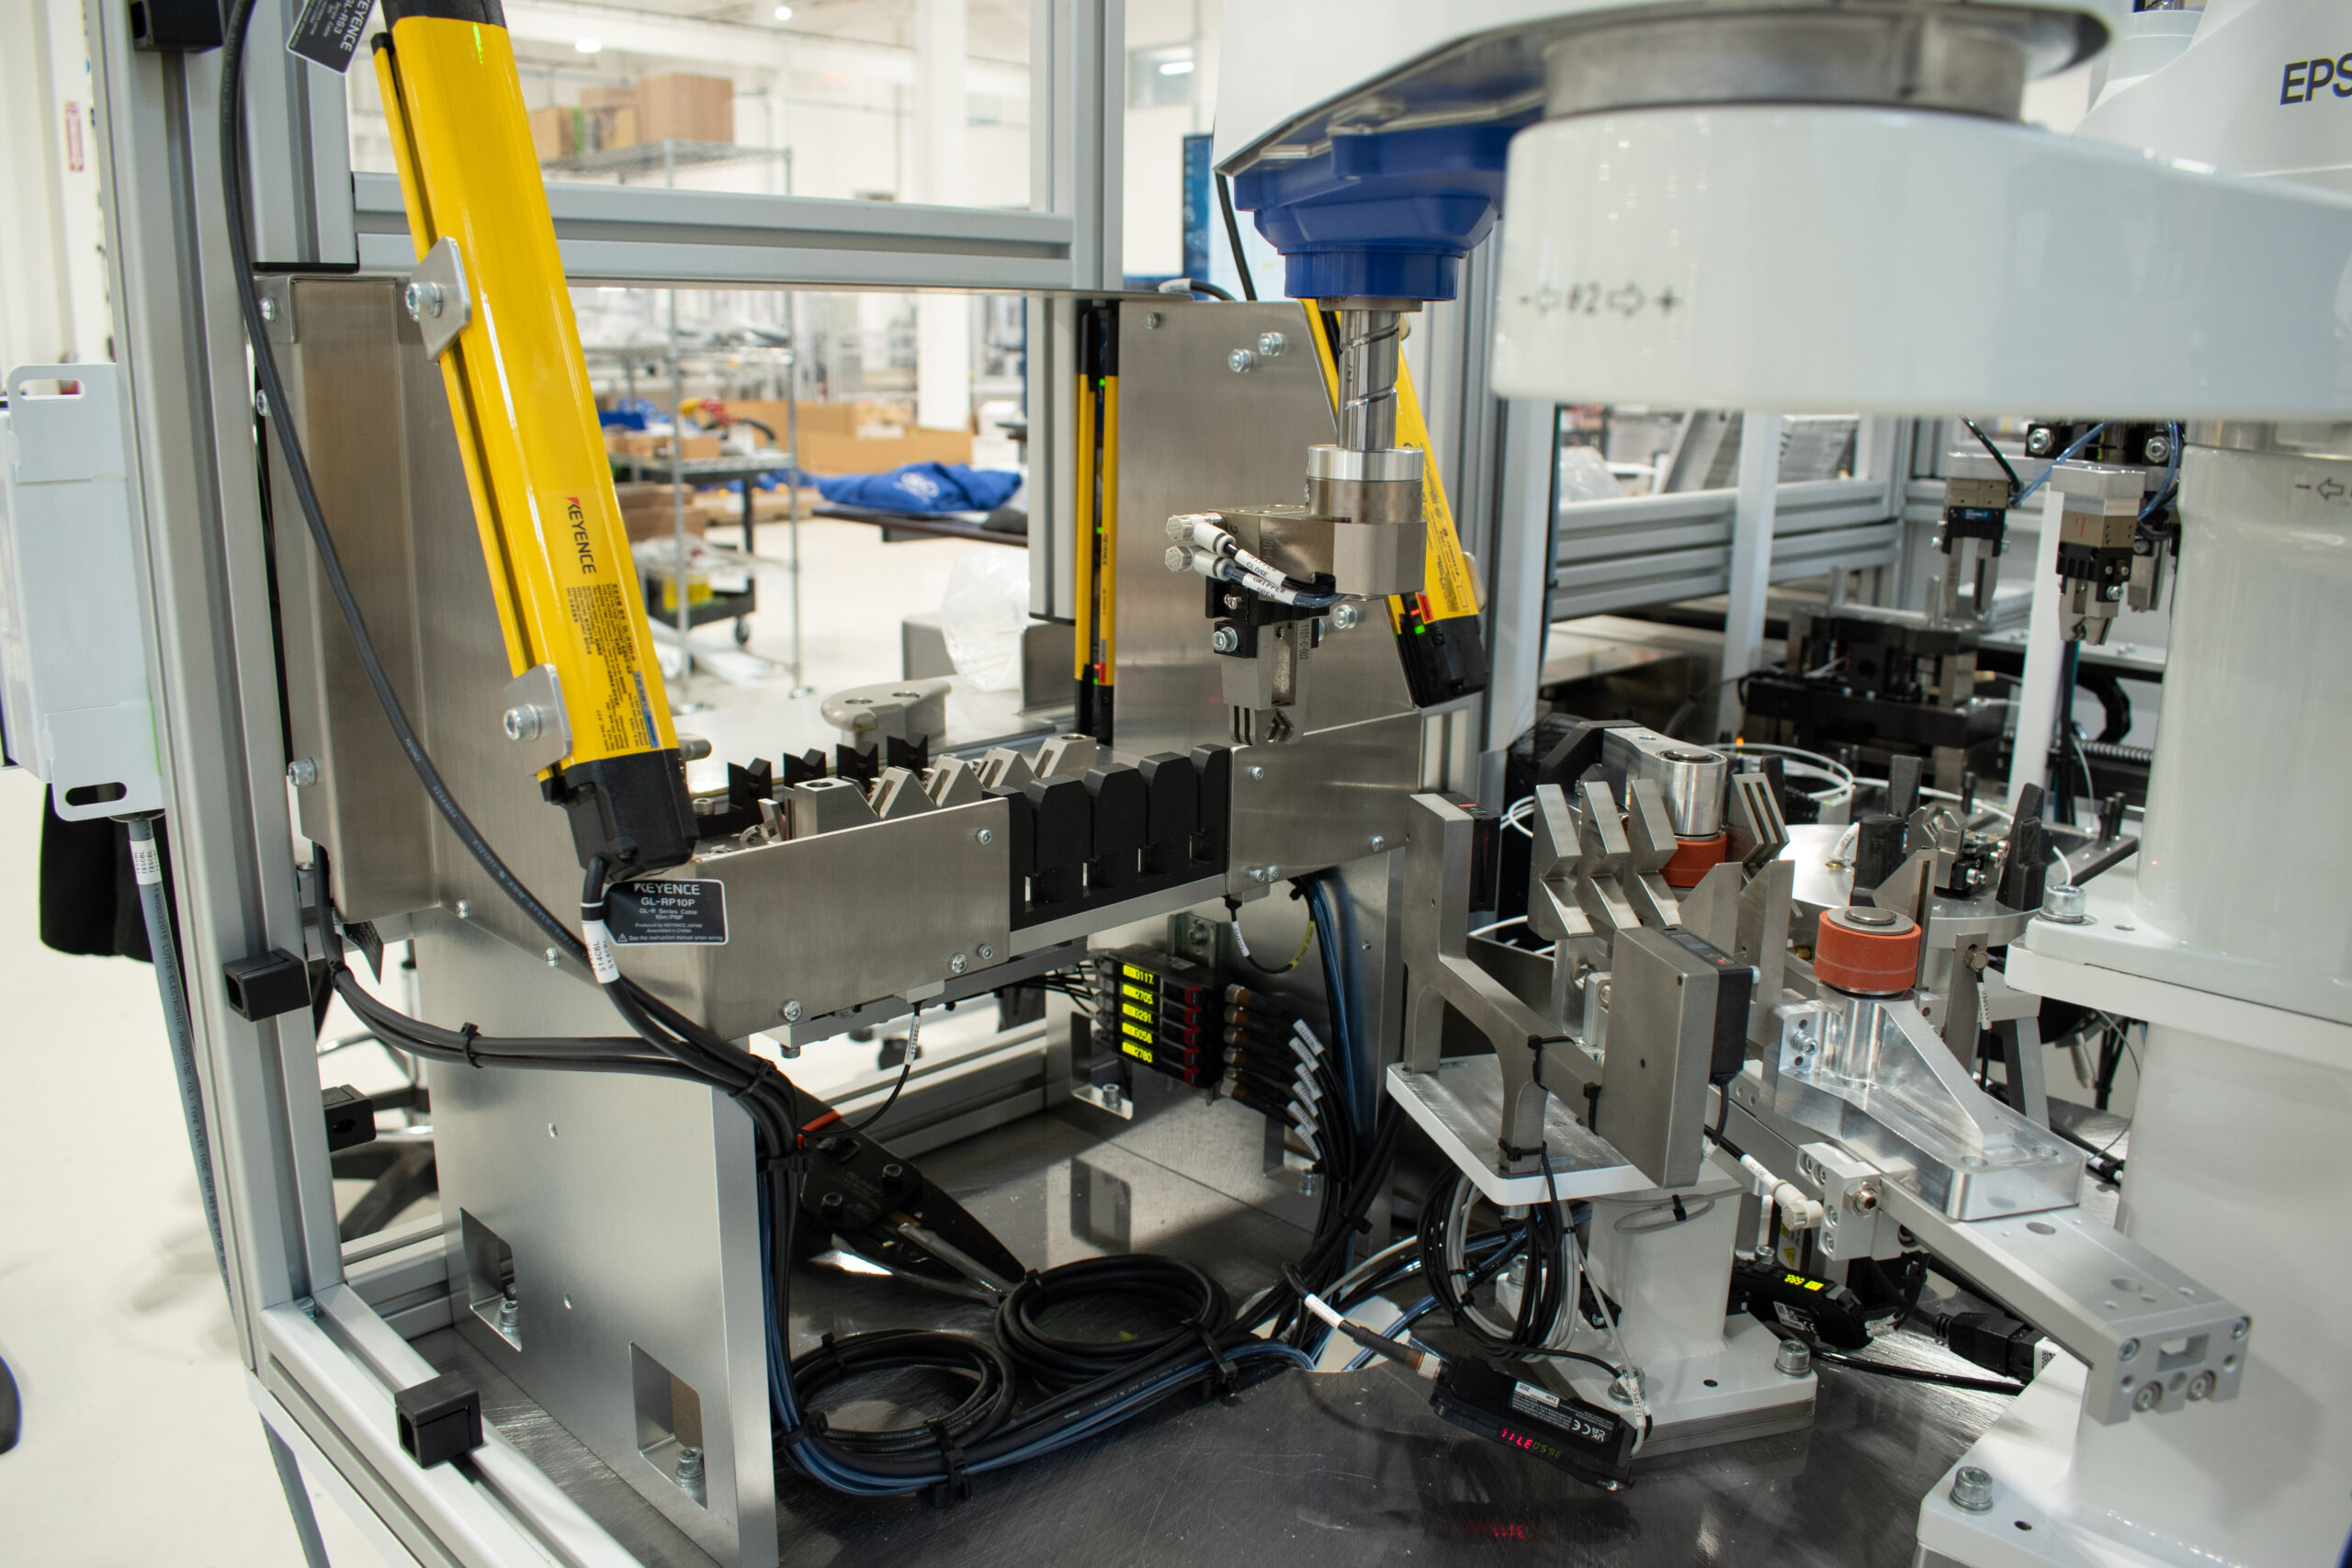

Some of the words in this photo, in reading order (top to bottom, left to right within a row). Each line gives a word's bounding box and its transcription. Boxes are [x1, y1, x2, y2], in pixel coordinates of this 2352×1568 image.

[2280, 52, 2352, 105] EPS
[565, 495, 596, 574] KEYENCE
[1245, 560, 1269, 578] CLOSE
[1252, 577, 1285, 593] GRIPPER
[634, 883, 700, 895] KEYENCE
[641, 897, 695, 907] GL-RP10P
